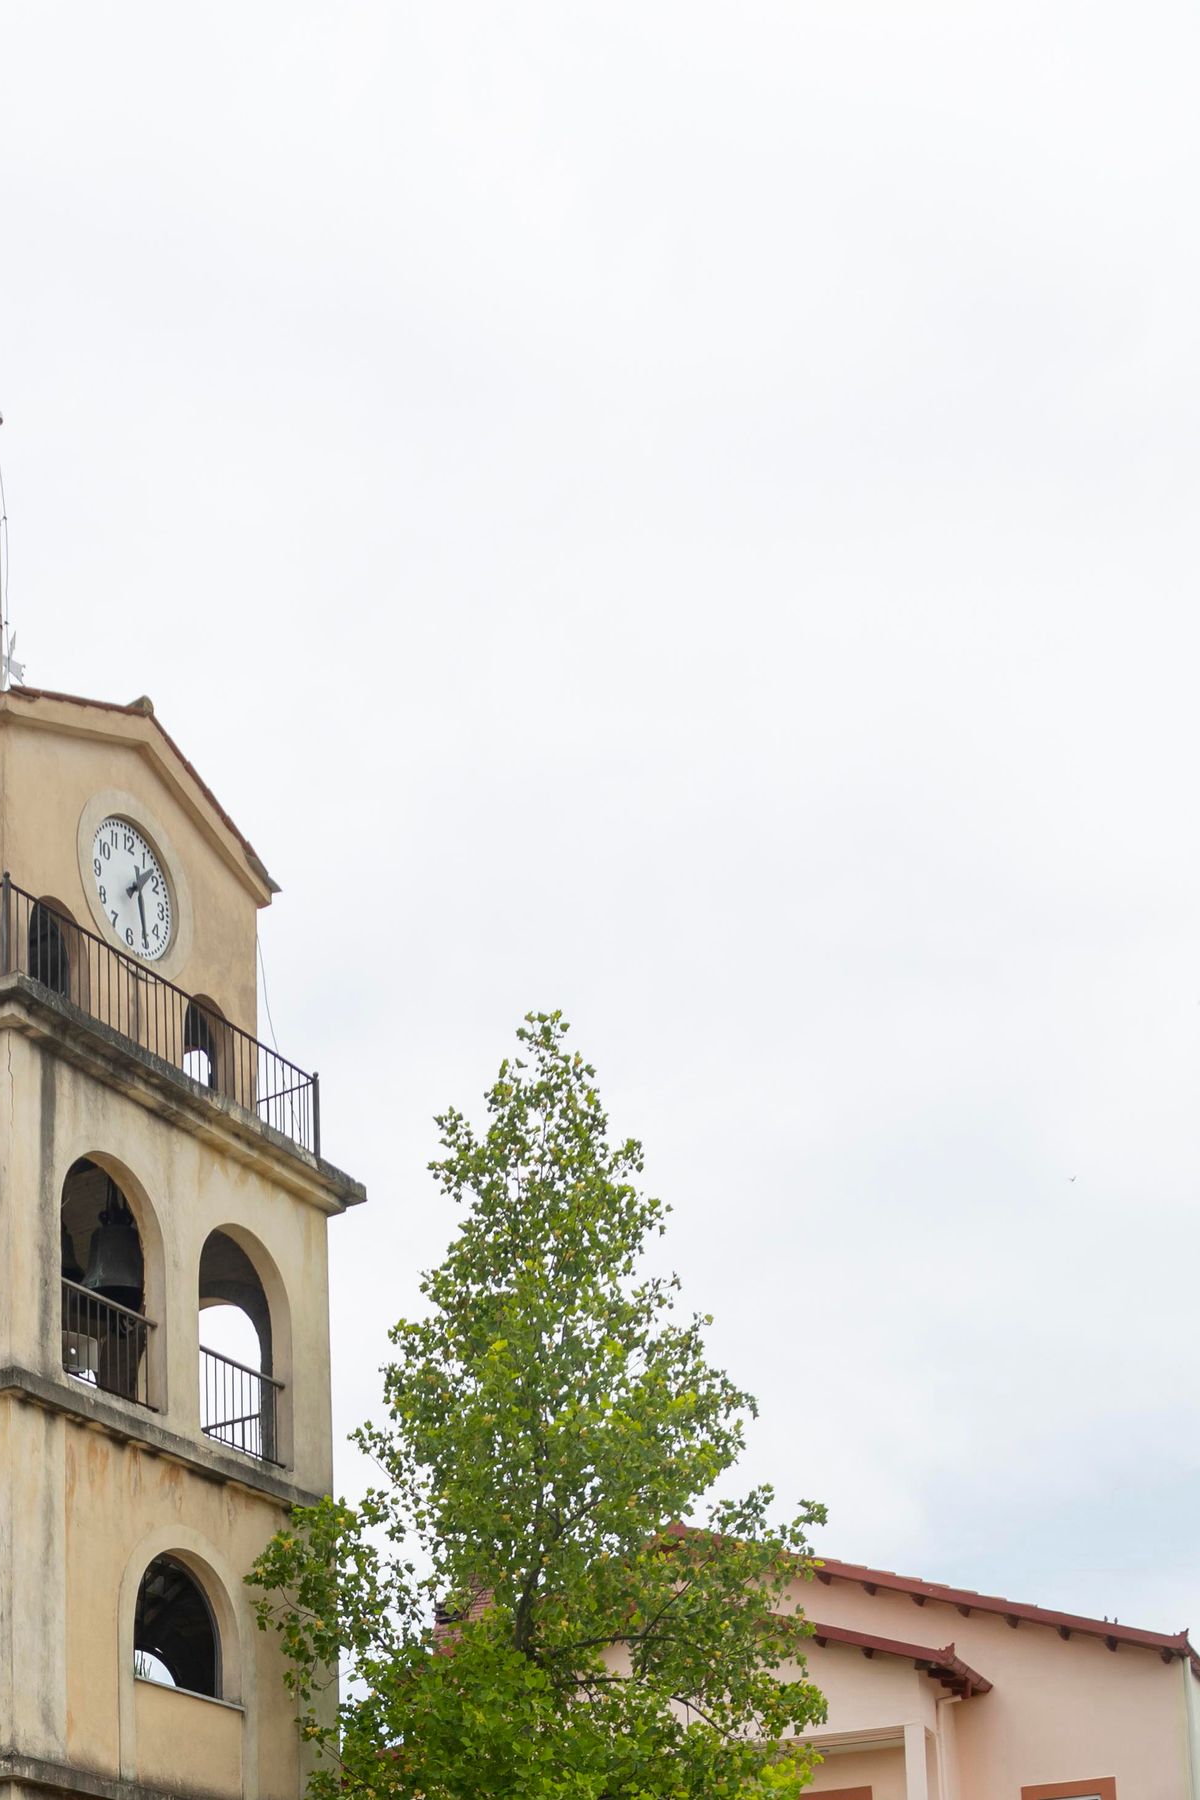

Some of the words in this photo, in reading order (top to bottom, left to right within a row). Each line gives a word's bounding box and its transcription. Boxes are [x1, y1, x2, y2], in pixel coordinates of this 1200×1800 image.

[99, 839, 111, 860] 10
[111, 830, 118, 850] 11
[124, 833, 135, 856] 12
[94, 858, 101, 877] 9
[99, 885, 106, 904] 8
[151, 875, 159, 895] 2
[111, 910, 118, 928] 7
[157, 902, 165, 921] 3
[126, 928, 134, 946] 6
[152, 924, 159, 940] 4
